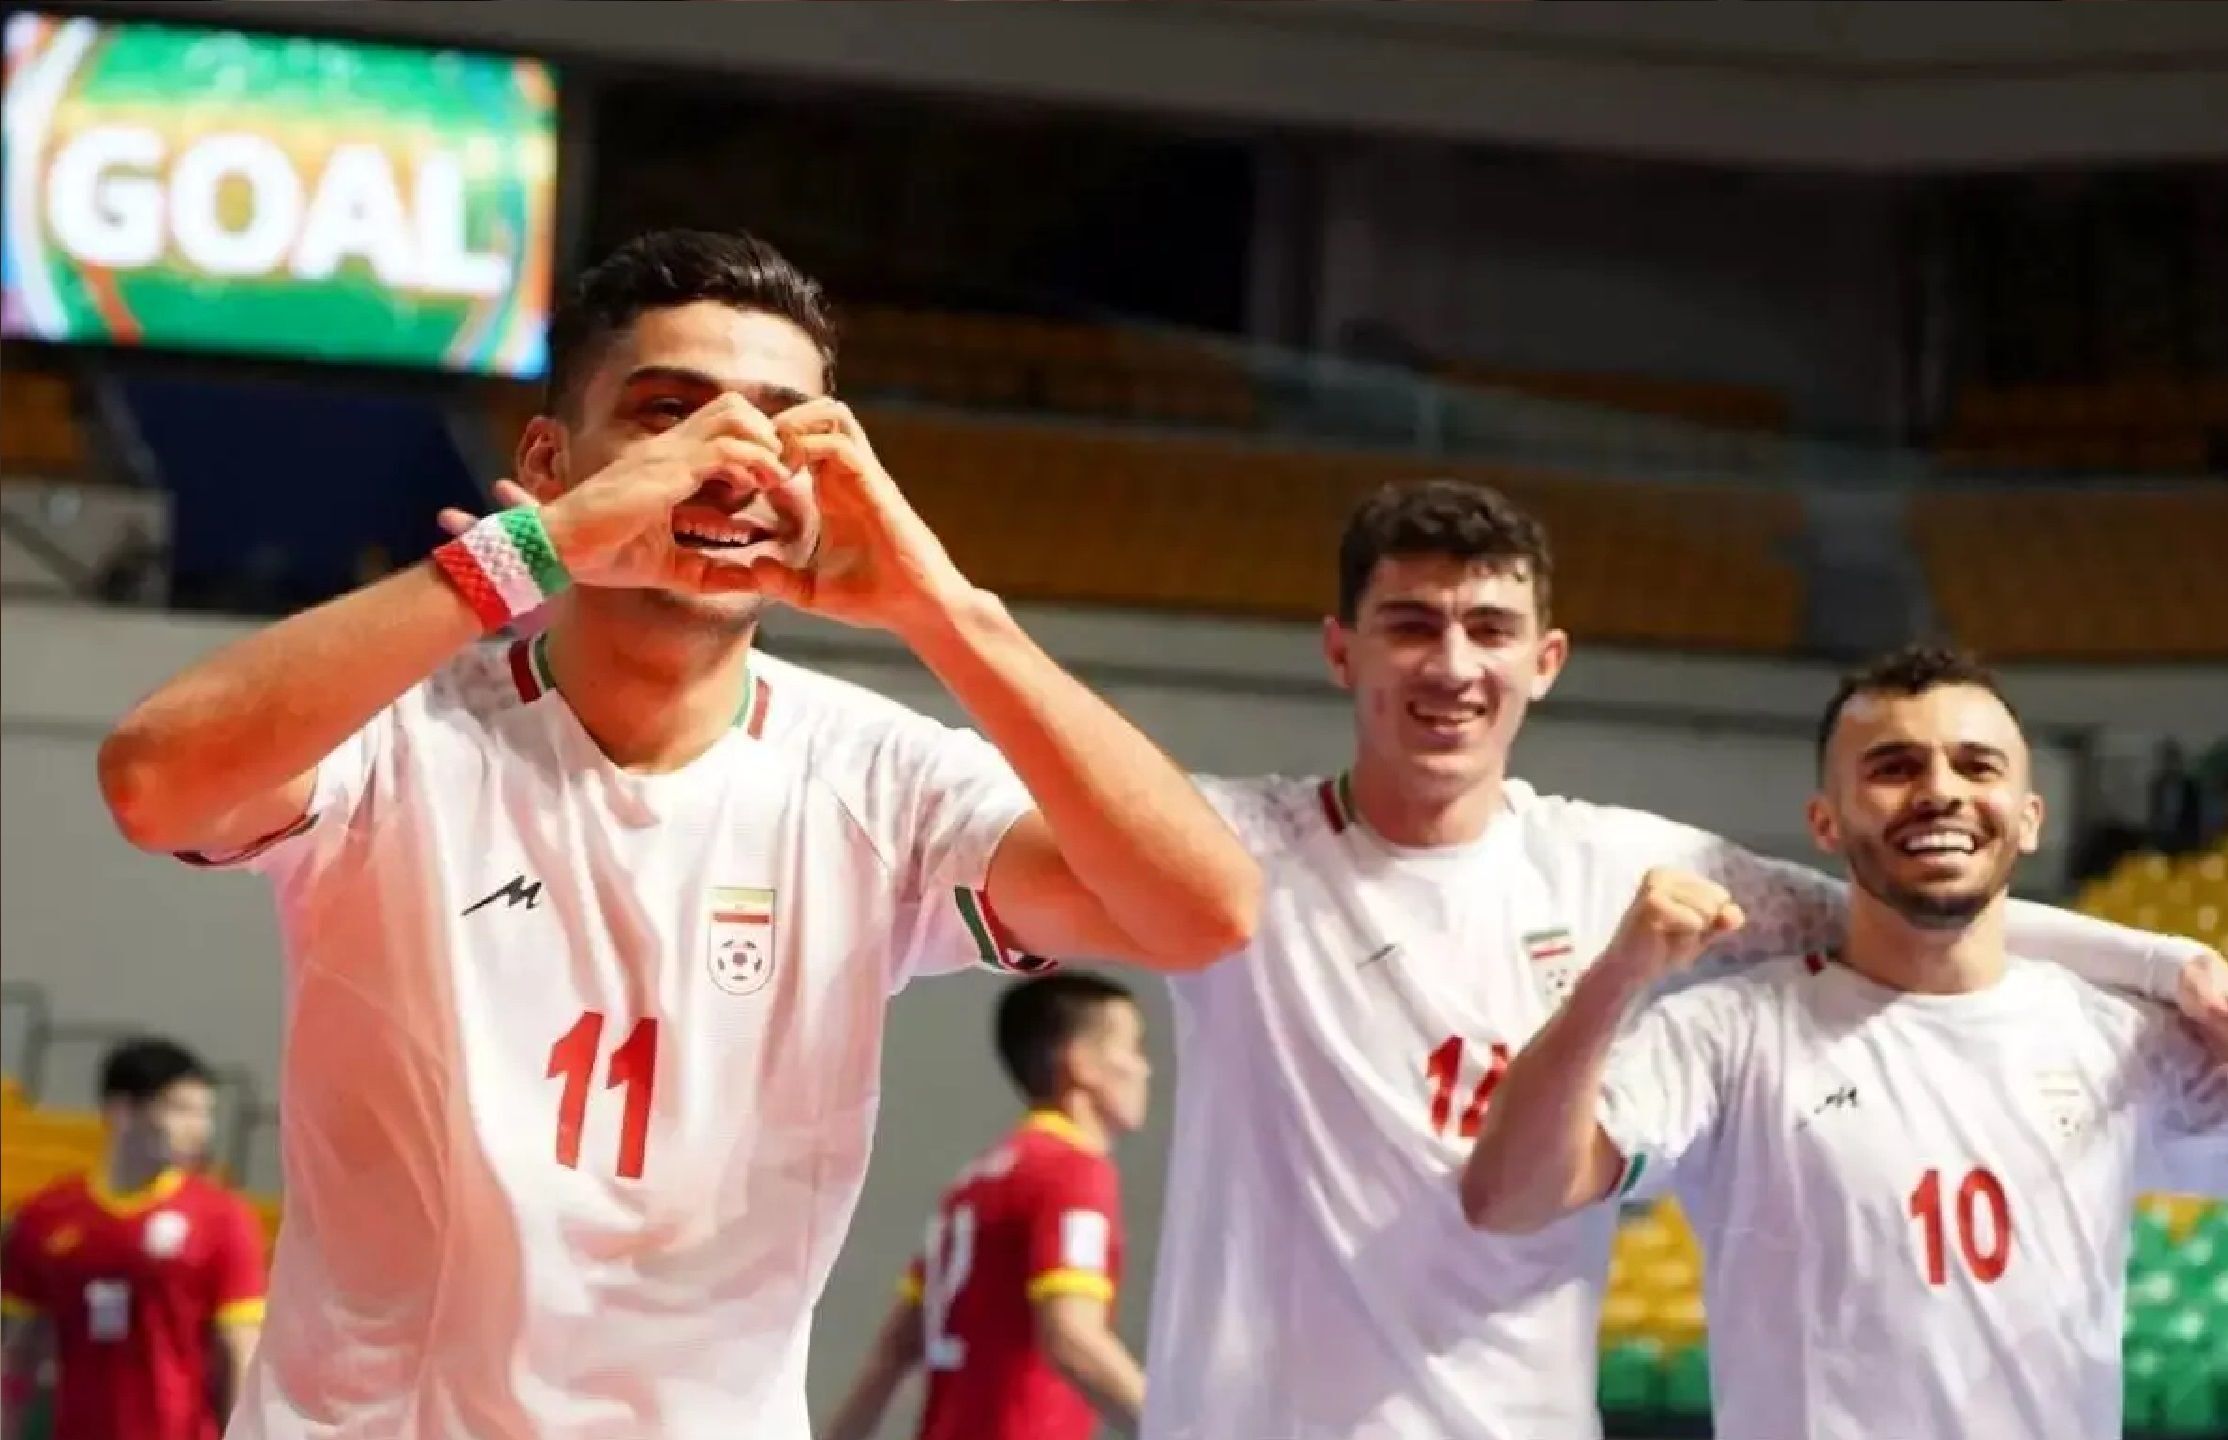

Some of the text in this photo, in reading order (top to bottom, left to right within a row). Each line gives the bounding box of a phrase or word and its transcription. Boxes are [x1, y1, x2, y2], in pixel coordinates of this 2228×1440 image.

[48, 124, 511, 297] GOAL
[546, 1010, 658, 1179] 11
[1909, 1167, 2011, 1285] 10
